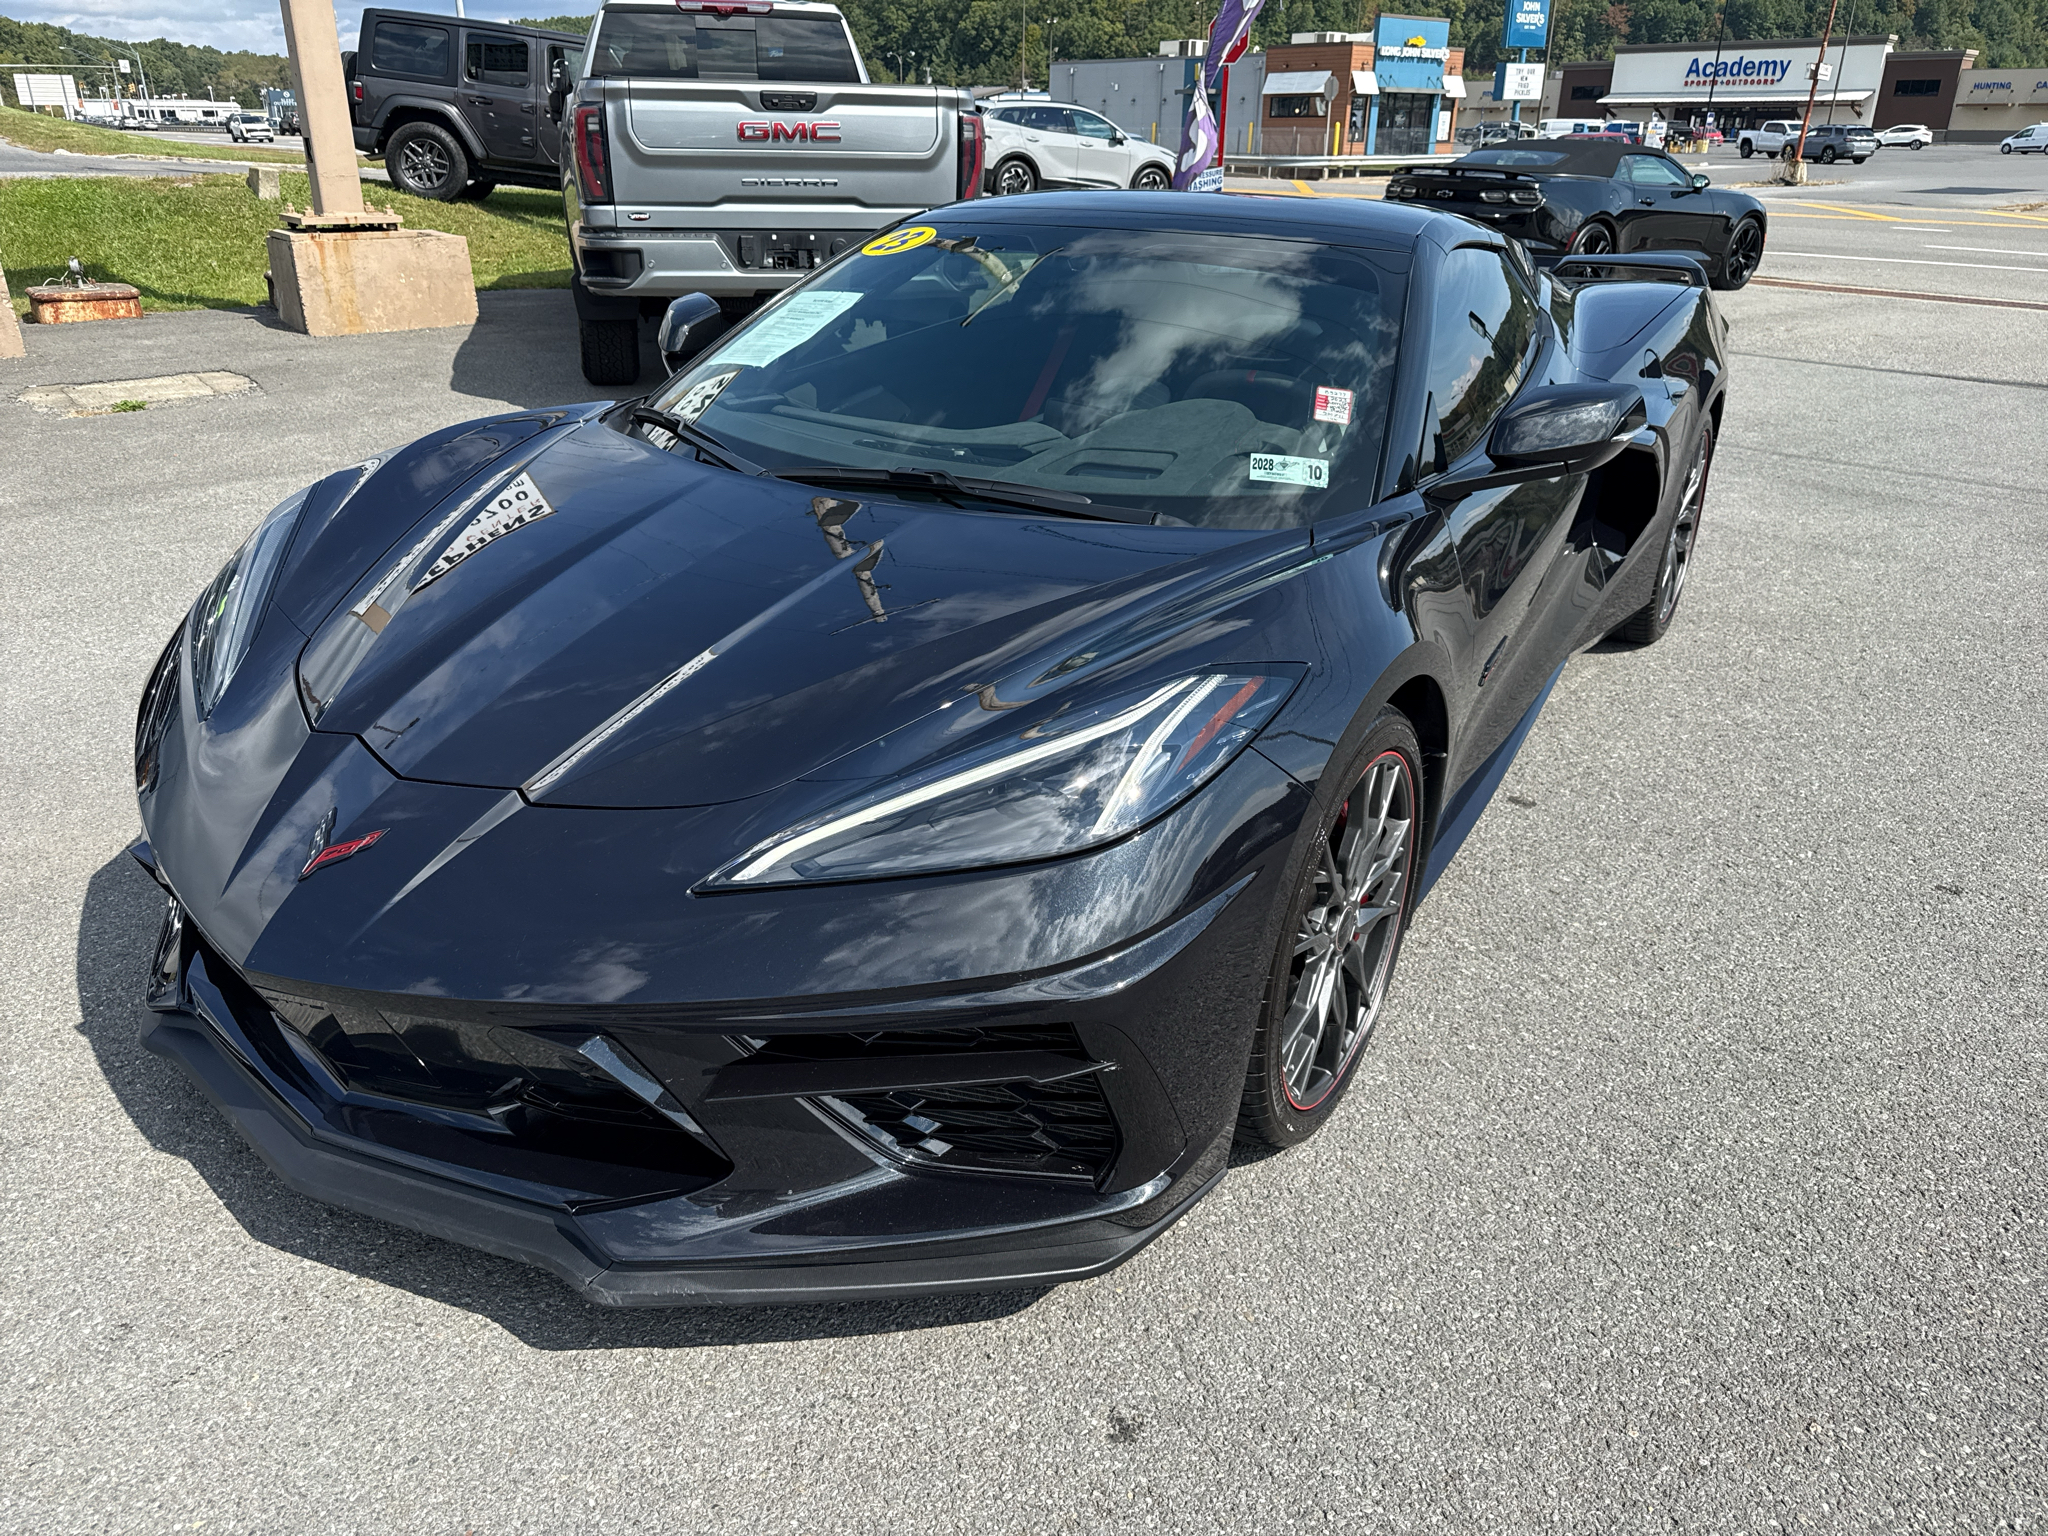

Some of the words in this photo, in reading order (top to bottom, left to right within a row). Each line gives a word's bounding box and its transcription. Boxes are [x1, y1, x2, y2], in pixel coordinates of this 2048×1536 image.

[1523, 1, 1541, 11] JOHN
[1516, 12, 1545, 27] SILVER'S
[1381, 46, 1401, 56] LONG
[1401, 47, 1420, 57] JOHN
[1421, 47, 1450, 62] SILVER'S
[1685, 56, 1792, 82] Academy
[1684, 79, 1718, 87] SPORTS
[1973, 81, 2012, 90] HUNTING
[738, 120, 841, 142] GMC
[741, 178, 838, 187] SIERRA
[1200, 169, 1222, 181] ESSURE
[868, 231, 927, 251] 23
[1252, 457, 1274, 471] 2028
[1308, 464, 1322, 480] 10
